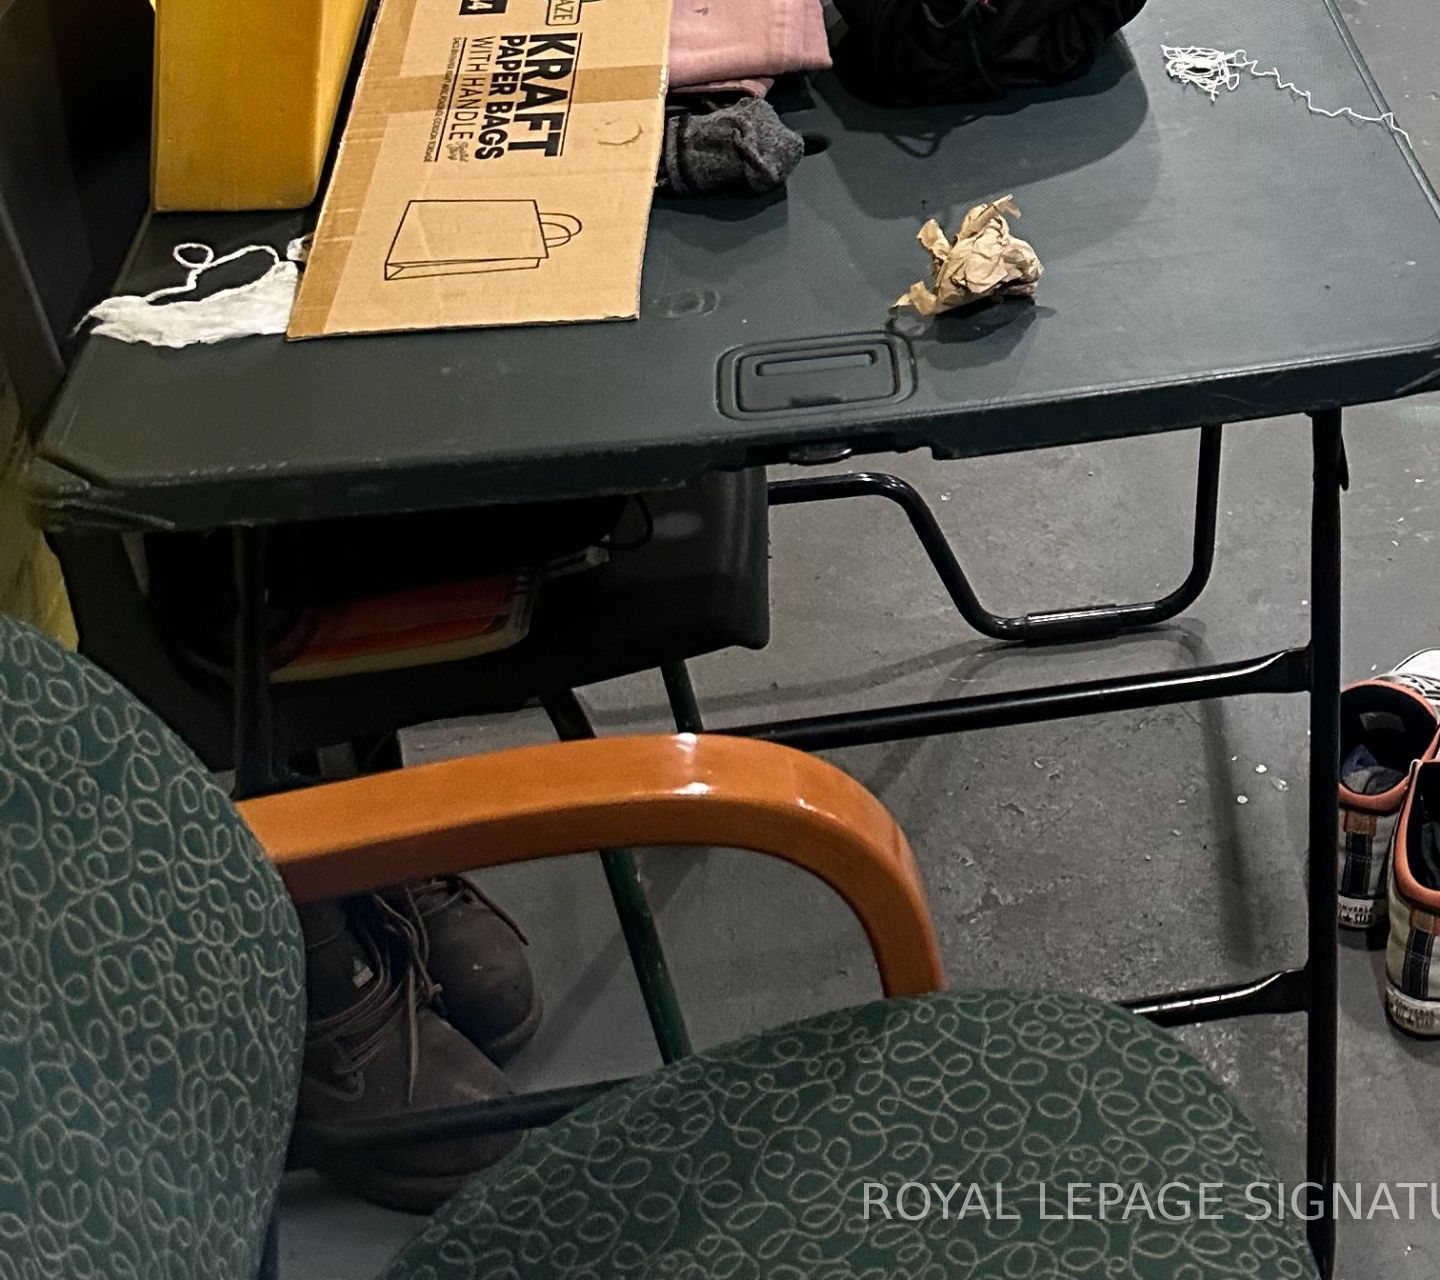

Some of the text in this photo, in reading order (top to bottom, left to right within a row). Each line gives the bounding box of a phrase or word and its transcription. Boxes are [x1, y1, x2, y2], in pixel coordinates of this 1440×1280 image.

[448, 36, 496, 141] WITH HANDLE
[474, 35, 528, 160] PAPER BAGS
[507, 32, 579, 157] KRAFT
